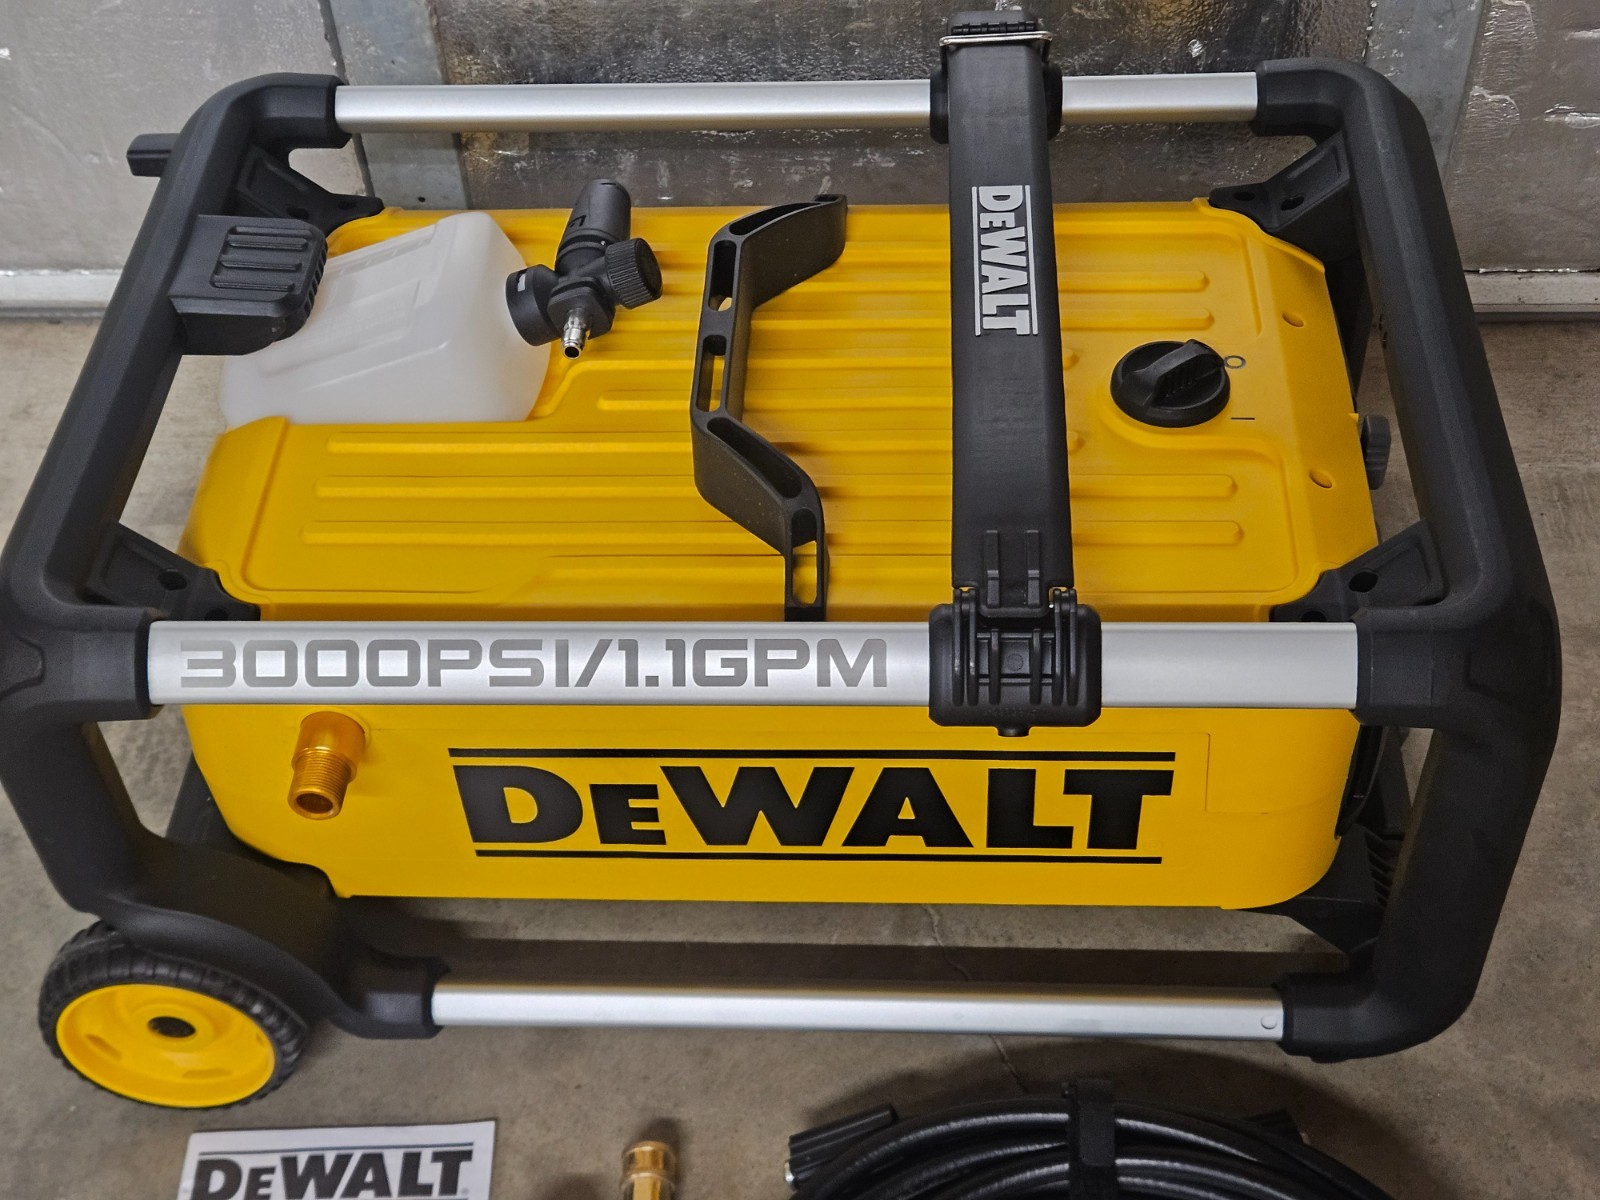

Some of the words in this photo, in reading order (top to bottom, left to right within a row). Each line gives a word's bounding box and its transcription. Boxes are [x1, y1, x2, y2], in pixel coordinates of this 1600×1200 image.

[979, 185, 1030, 335] DEWALT
[180, 639, 887, 687] 3000PSI/1.1GPM
[453, 765, 1174, 850] DEWALT
